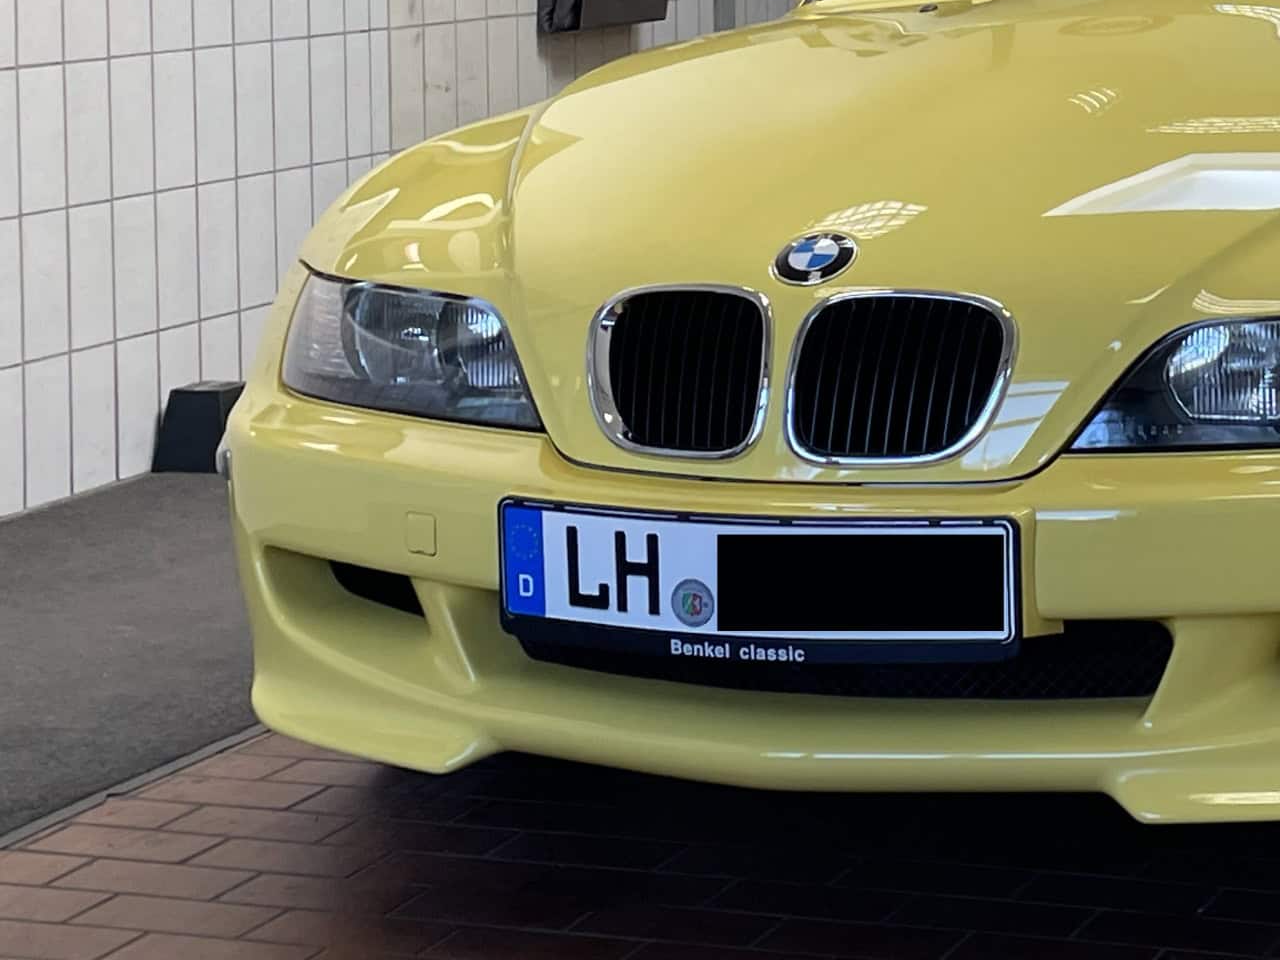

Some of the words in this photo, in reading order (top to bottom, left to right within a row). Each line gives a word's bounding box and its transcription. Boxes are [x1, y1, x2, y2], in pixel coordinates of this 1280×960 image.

[518, 574, 534, 597] D
[566, 525, 661, 616] LH
[670, 638, 730, 658] Benkel
[739, 643, 805, 662] classic
